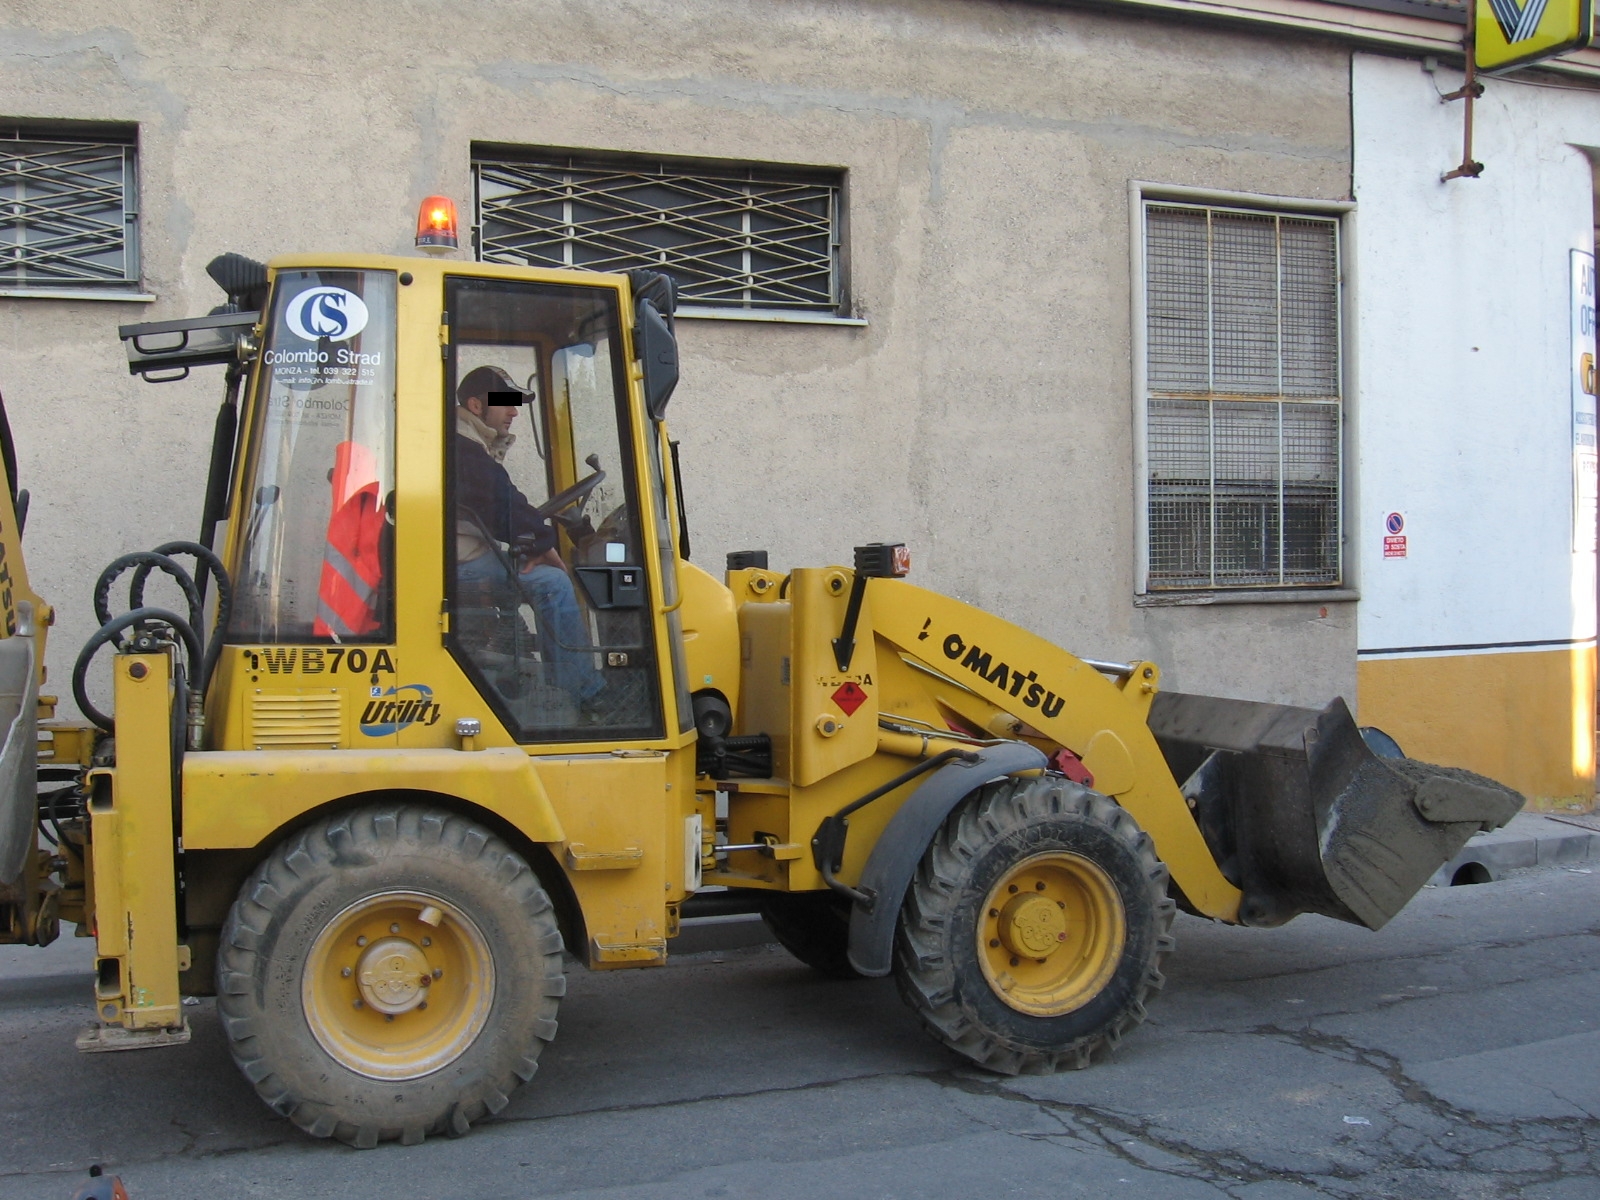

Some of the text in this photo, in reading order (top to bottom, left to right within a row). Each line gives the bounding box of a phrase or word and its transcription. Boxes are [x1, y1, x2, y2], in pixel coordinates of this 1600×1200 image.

[300, 292, 348, 337] CS
[264, 348, 381, 366] Colombo Strad
[274, 366, 302, 376] MONZA
[323, 367, 339, 375] 039
[341, 367, 357, 376] 322
[361, 368, 375, 377] 515
[263, 648, 396, 675] WB70A
[360, 698, 441, 727] Utility
